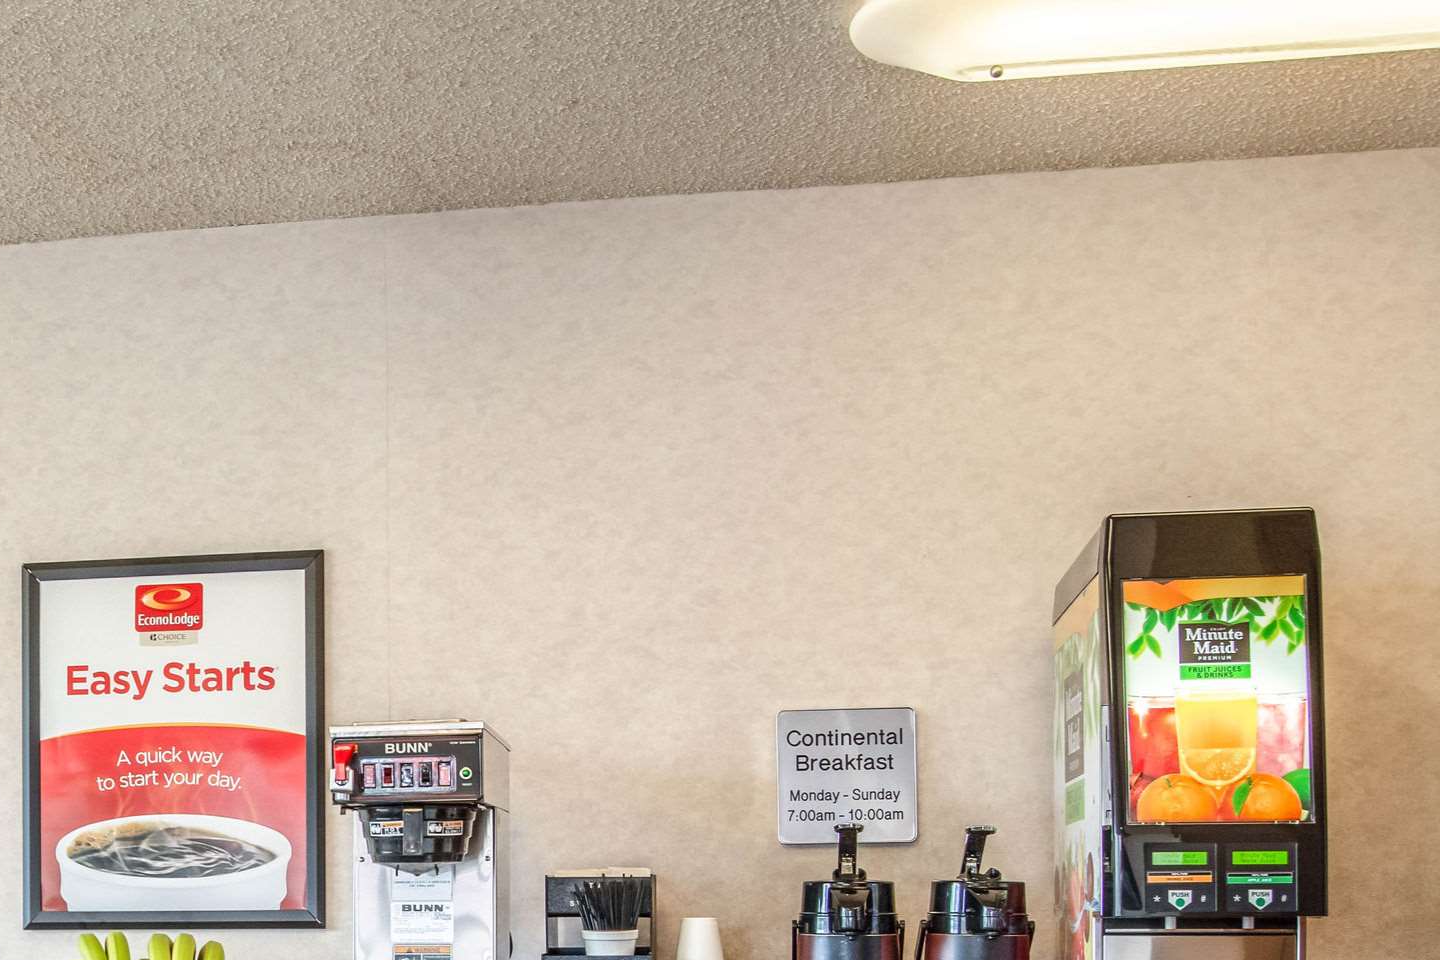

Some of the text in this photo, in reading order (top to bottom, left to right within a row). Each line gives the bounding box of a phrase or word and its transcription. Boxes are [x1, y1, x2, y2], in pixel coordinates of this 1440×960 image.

[138, 612, 200, 627] EconoLodge
[157, 633, 187, 641] CHOICE
[1184, 627, 1244, 641] Minute
[1193, 640, 1236, 654] Maid
[66, 660, 276, 701] Easy Starts
[786, 727, 904, 747] Continental
[116, 746, 224, 768] A quick way
[795, 753, 895, 772] Breakfast
[96, 770, 243, 792] to start your day.
[789, 789, 840, 804] Monday
[852, 788, 901, 803] Sunday
[787, 809, 836, 822] 7:00am
[848, 808, 904, 821] 10:00am
[401, 904, 444, 912] BUNN
